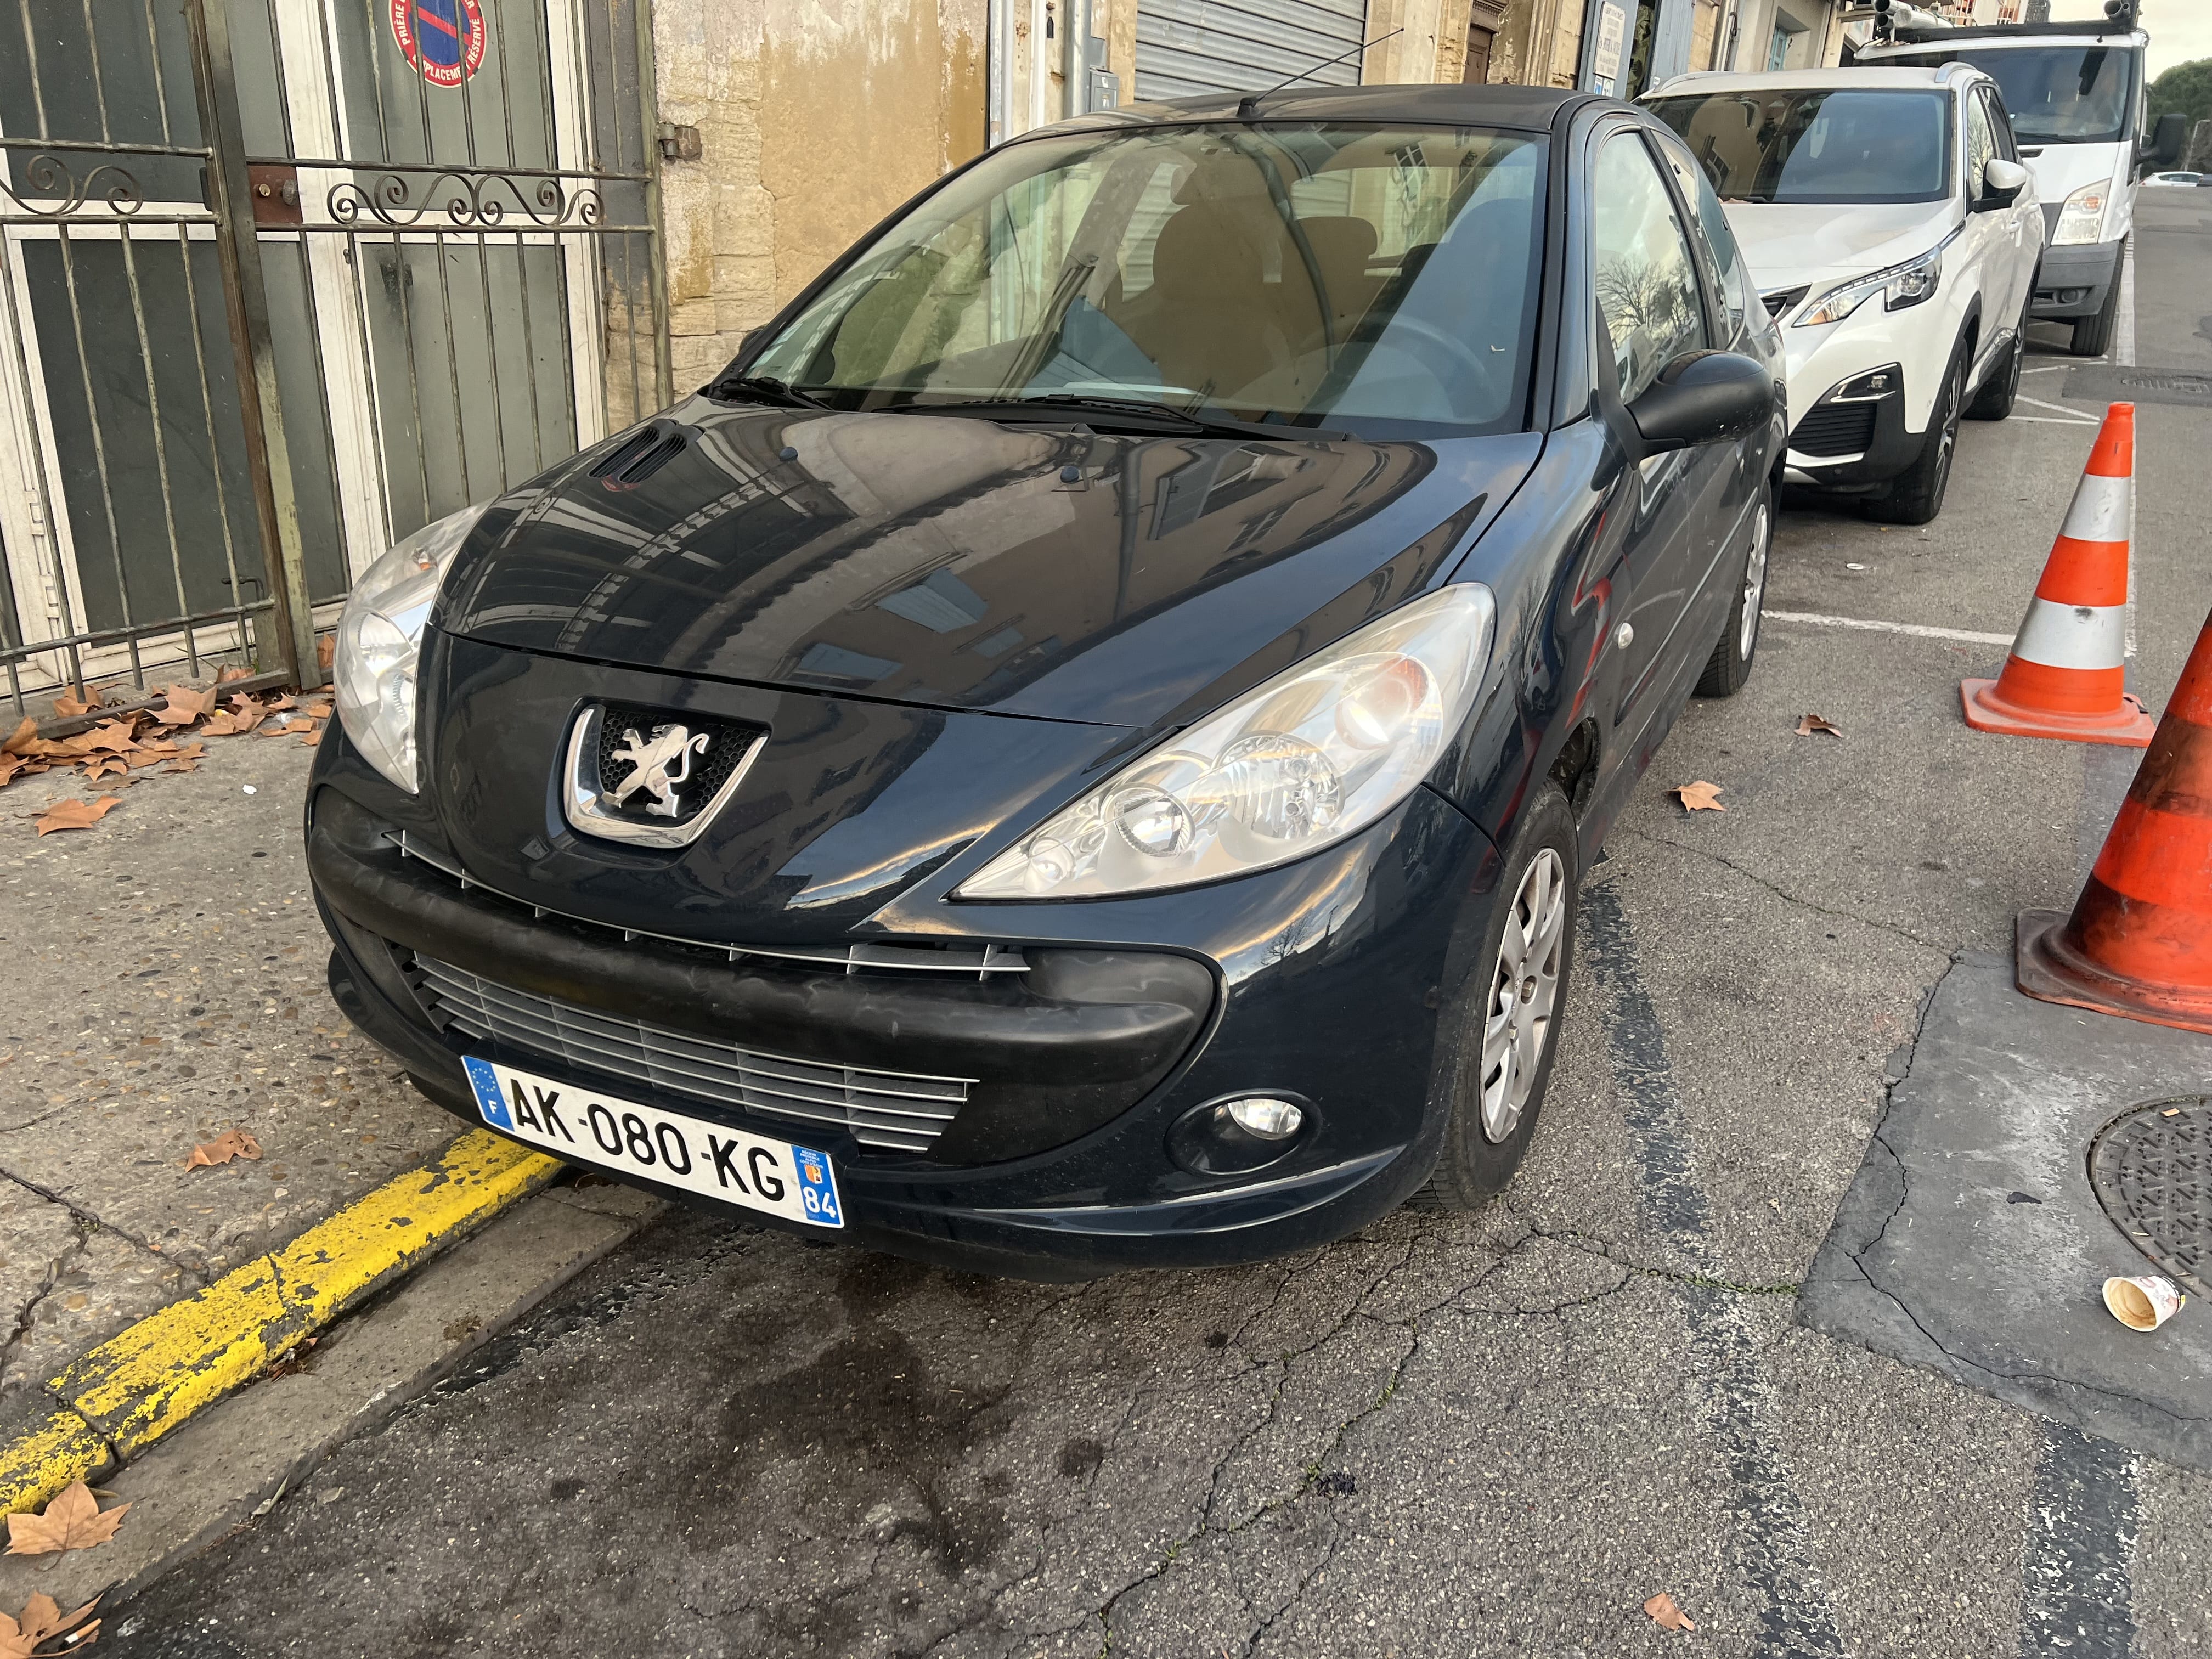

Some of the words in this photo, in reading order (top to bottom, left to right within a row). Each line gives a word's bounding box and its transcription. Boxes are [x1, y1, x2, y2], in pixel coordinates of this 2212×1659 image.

[394, 3, 411, 46] PRIÈRE
[467, 18, 482, 65] RÉSERVÉ
[488, 1099, 497, 1114] F
[803, 1186, 836, 1218] 84
